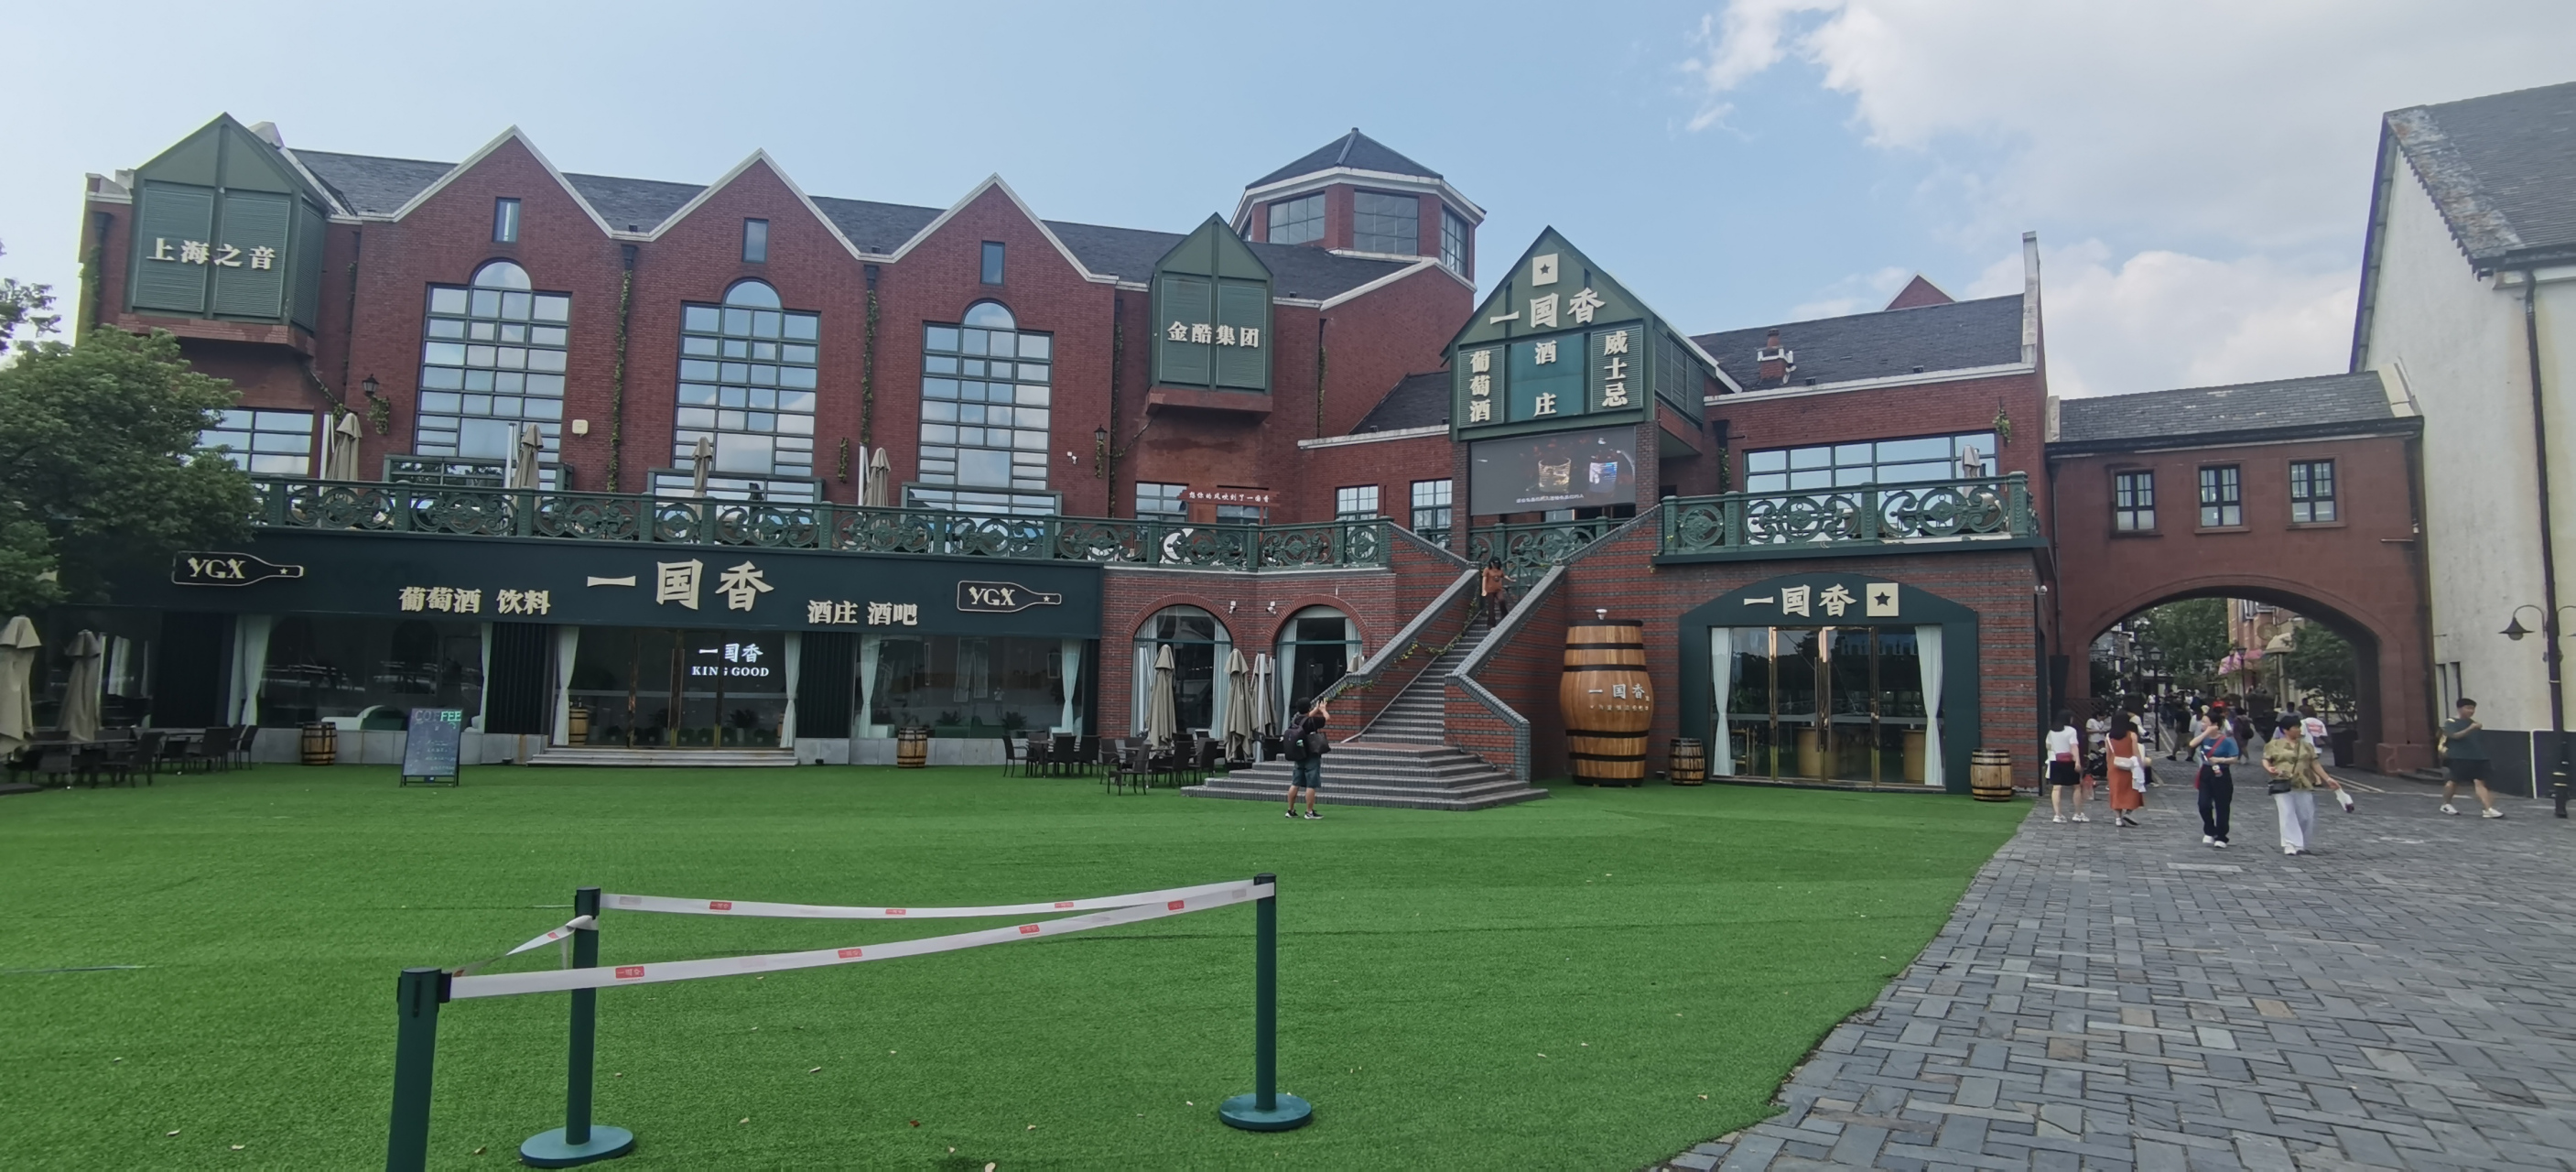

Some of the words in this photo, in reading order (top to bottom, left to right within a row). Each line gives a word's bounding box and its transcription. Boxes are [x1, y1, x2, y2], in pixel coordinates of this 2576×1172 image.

[146, 237, 276, 270] 上海之音
[1489, 287, 1606, 329] 一国香
[1167, 320, 1259, 348] 金酷集团
[1533, 340, 1557, 418] 酒庄
[1602, 331, 1628, 407] 威士忌
[1469, 350, 1491, 423] 葡萄酒
[188, 557, 246, 579] YGX
[587, 558, 774, 612] 一国香
[969, 586, 1016, 606] YGX
[398, 586, 482, 613] 葡萄酒
[496, 589, 551, 615] 饮料
[807, 600, 859, 624] 酒庄
[867, 601, 918, 626] 酒吧
[1743, 582, 1857, 617] 一国香
[698, 643, 763, 663] 一国香
[731, 667, 770, 677] GOOD
[1588, 682, 1645, 700] 一国香
[416, 710, 462, 722] COFFEE
